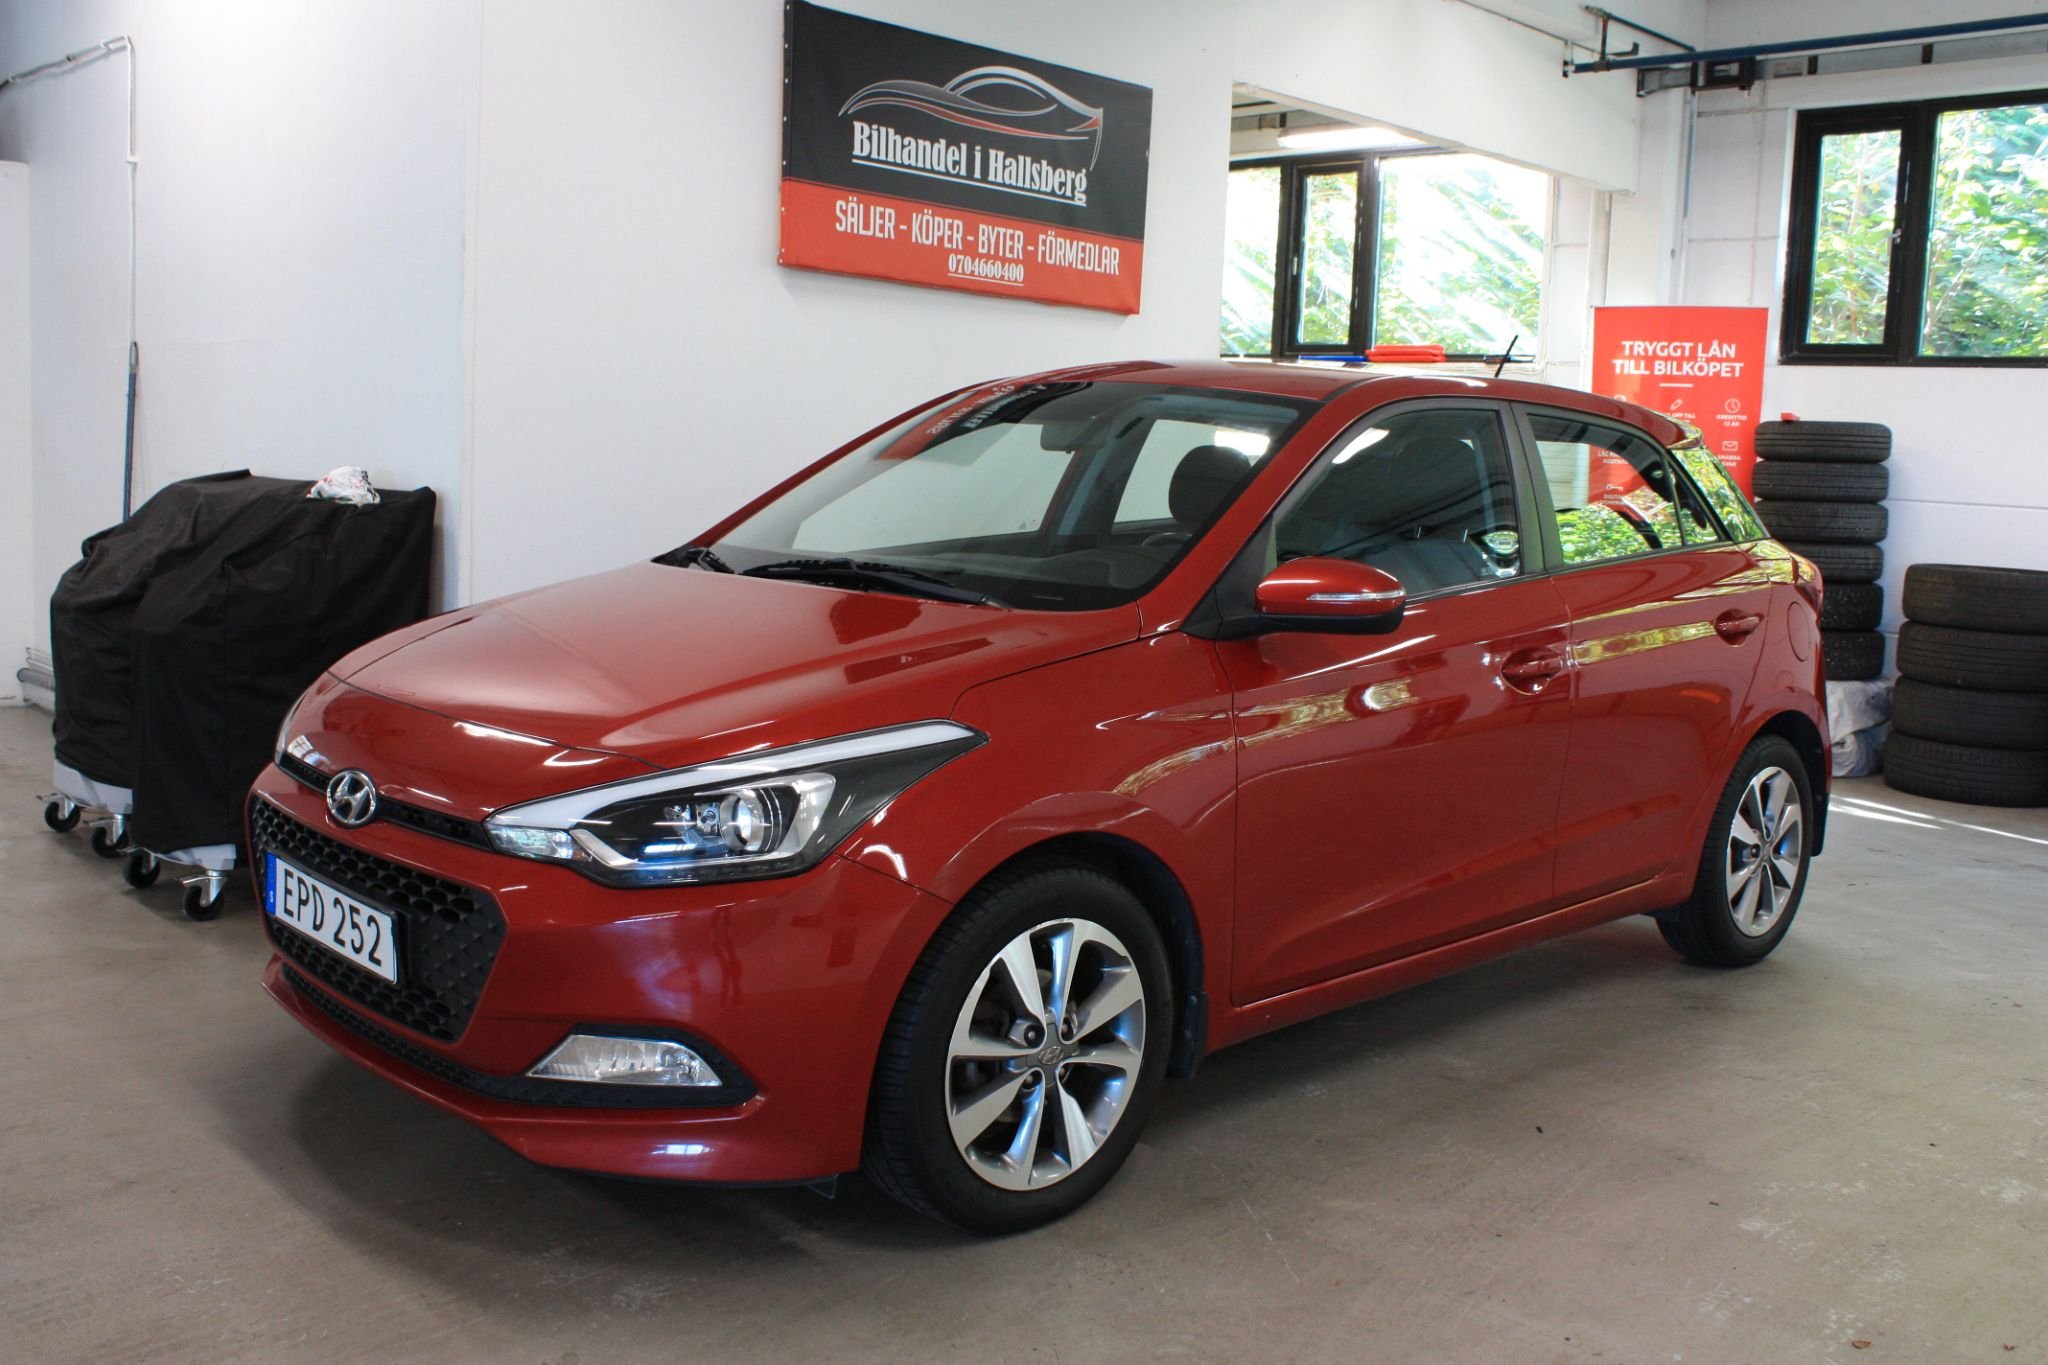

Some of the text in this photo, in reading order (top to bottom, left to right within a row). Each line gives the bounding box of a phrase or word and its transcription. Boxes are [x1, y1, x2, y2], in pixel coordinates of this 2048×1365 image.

[852, 121, 1087, 204] Bilhandel i Hallsberg
[835, 196, 895, 240] SÄLJER
[911, 209, 963, 250] KÖPER
[978, 224, 1024, 260] BYTER
[1037, 230, 1120, 275] FÖRMEDLAR
[948, 253, 1024, 282] 0704660400
[1612, 358, 1744, 378] TILL BILKÖPET
[1621, 339, 1736, 358] TRYGGT LÅN
[284, 868, 382, 967] EPD 252
